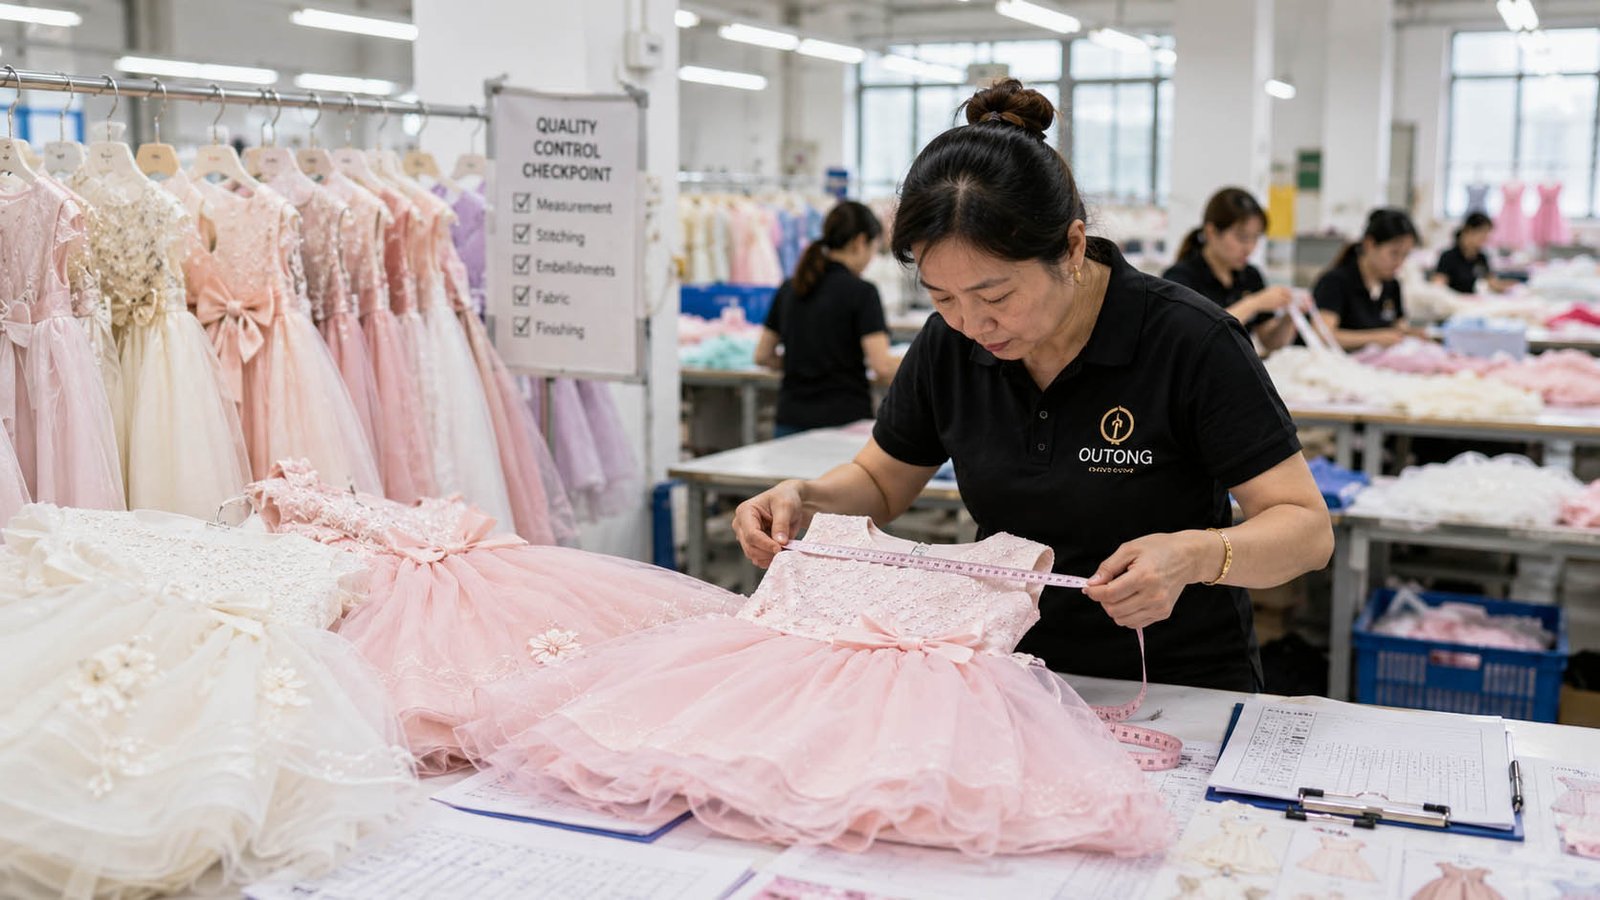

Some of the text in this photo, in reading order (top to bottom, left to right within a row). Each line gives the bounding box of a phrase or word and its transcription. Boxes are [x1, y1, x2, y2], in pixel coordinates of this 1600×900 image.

[536, 117, 597, 134] QUALITY
[533, 140, 601, 158] CONTROL
[522, 163, 612, 181] CHECKPOINT
[536, 198, 612, 214] Measurement
[536, 228, 585, 247] Stitching
[536, 260, 615, 277] Embellishments
[536, 290, 570, 306] Fabric
[536, 320, 585, 340] Finishing
[1079, 447, 1153, 465] OUTONG
